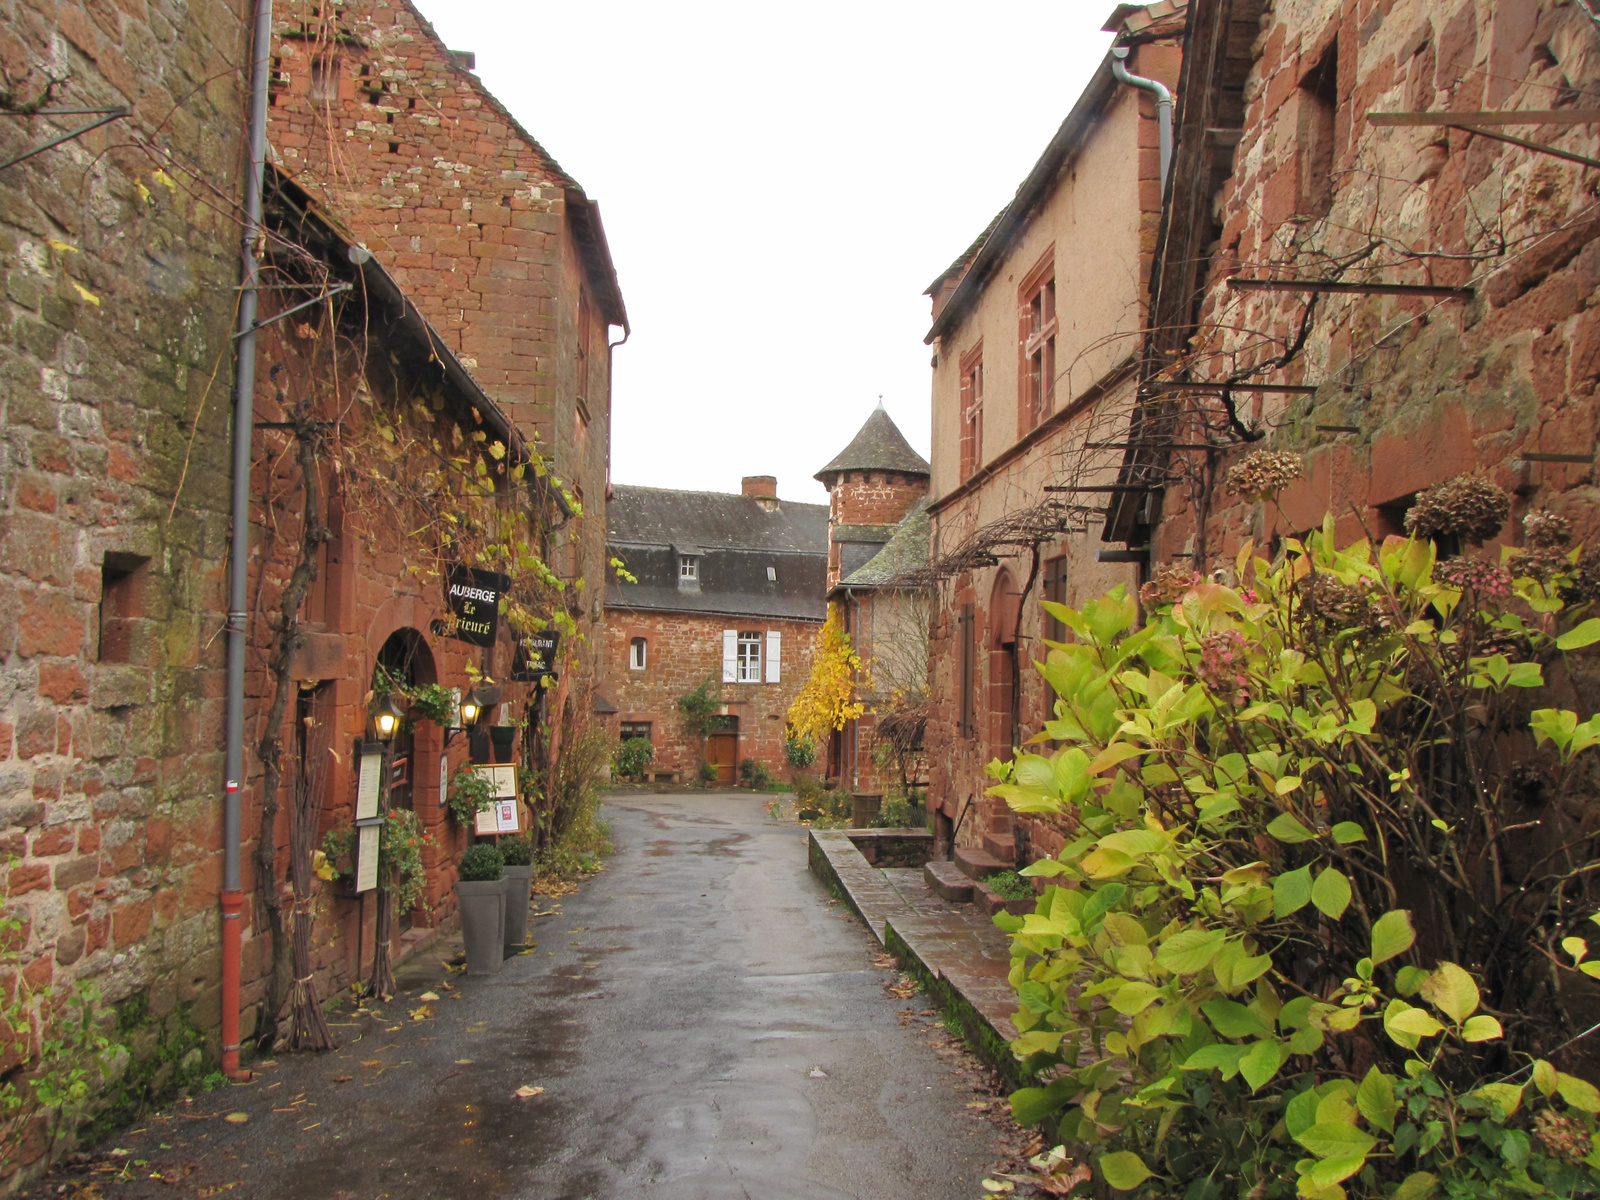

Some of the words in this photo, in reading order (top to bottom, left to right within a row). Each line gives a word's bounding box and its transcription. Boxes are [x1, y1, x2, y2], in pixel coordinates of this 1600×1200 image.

[449, 584, 496, 603] AUBERGE
[463, 601, 476, 615] Le
[450, 617, 491, 635] rieuré
